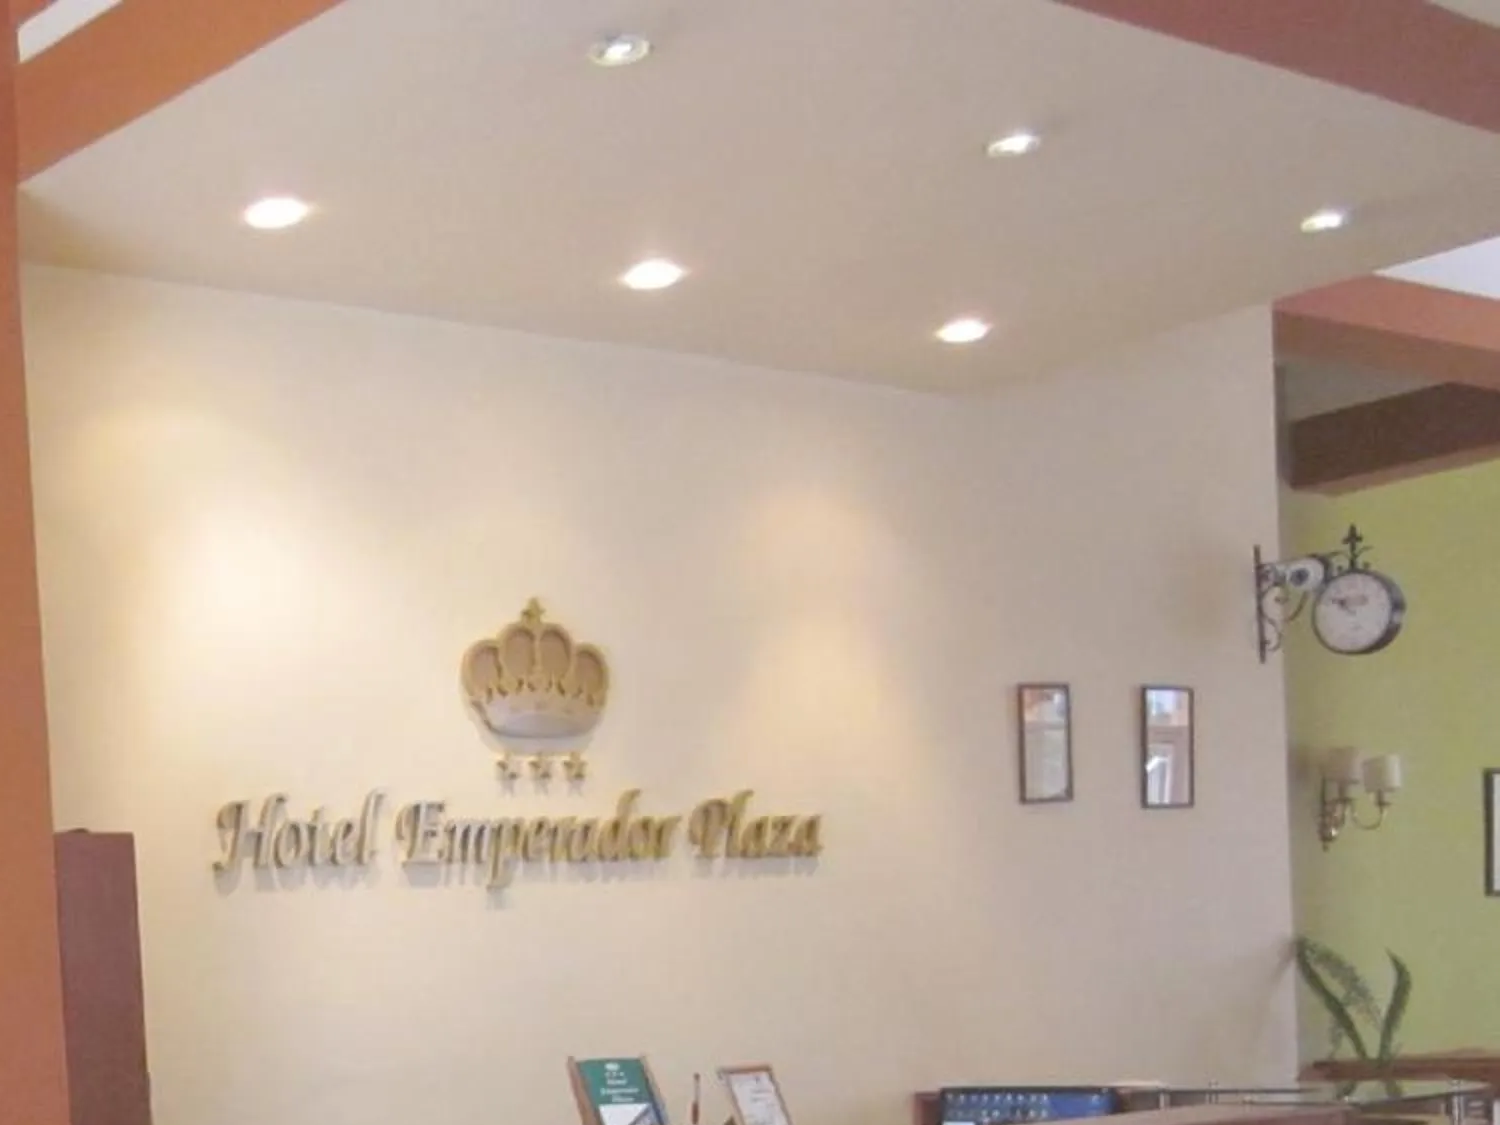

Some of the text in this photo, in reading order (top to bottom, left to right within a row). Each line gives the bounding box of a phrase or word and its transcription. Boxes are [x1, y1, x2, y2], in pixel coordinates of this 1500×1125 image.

[212, 789, 823, 891] Hotel Emperador Plaza
